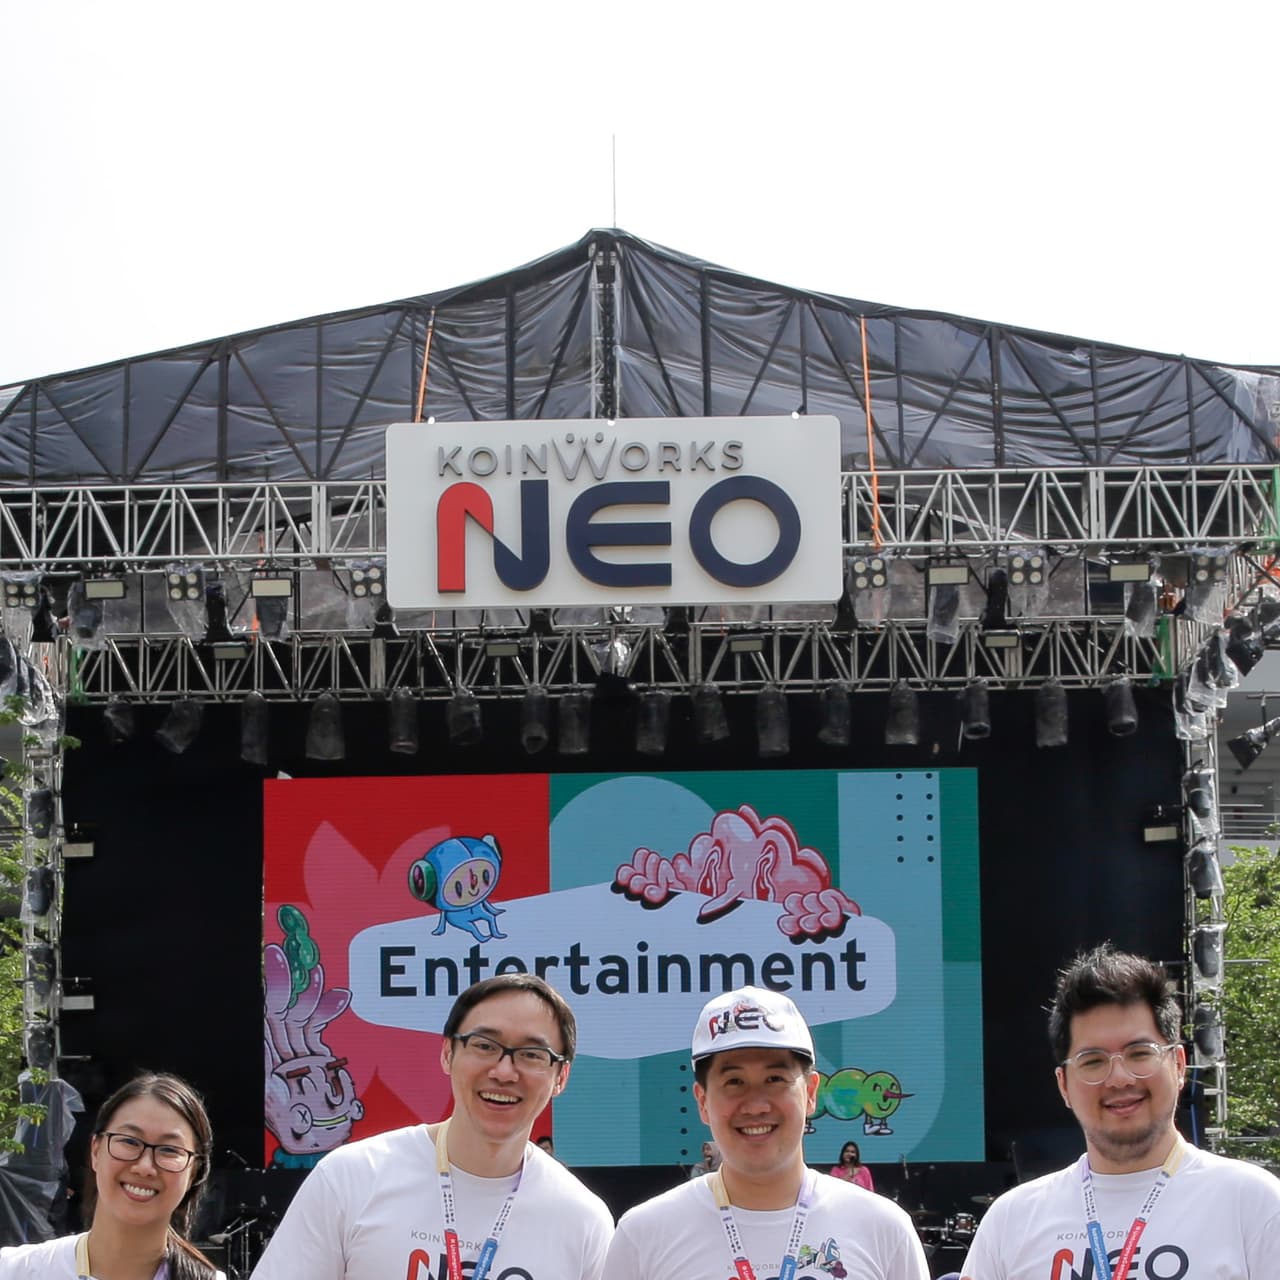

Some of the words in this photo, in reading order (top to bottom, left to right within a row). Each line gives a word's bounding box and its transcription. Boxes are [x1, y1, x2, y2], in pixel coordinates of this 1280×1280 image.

[437, 432, 745, 481] KOINWORKS
[436, 475, 801, 594] NEO
[411, 1230, 482, 1251] KOINORK
[1056, 1229, 1128, 1241] KOINOR
